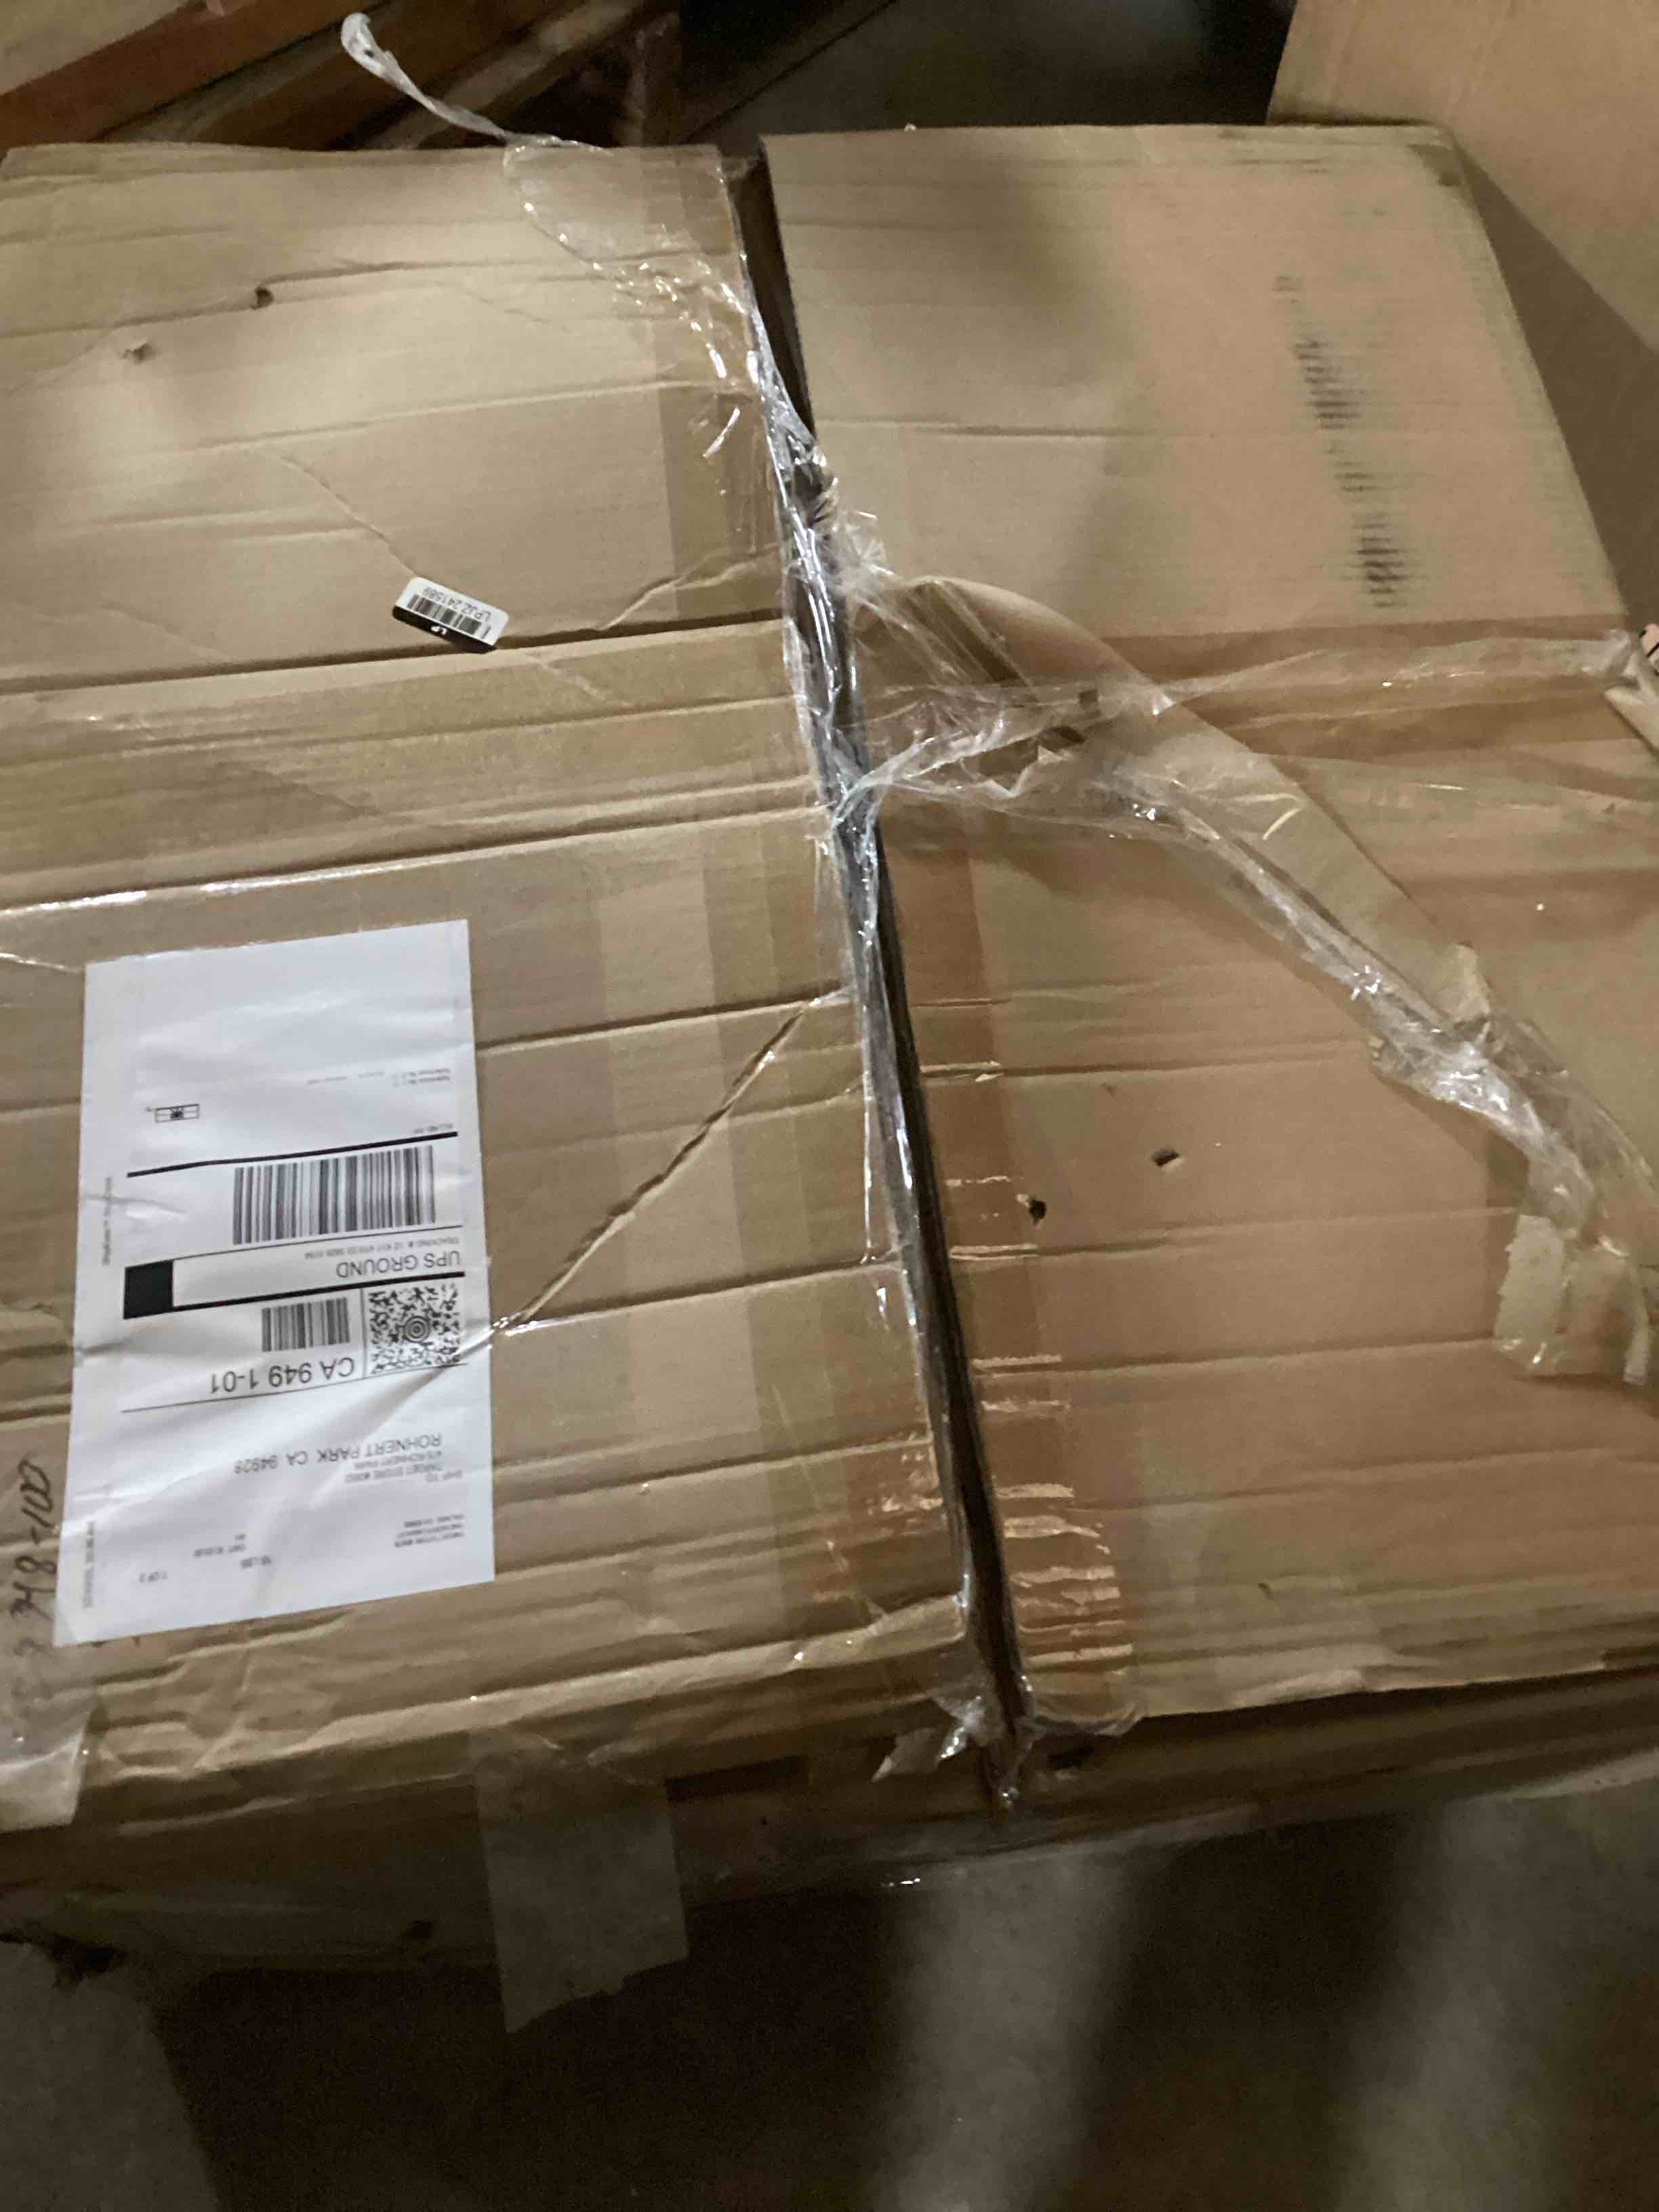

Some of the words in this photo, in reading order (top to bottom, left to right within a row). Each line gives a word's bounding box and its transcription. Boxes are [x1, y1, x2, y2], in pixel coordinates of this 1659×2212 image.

[336, 1255, 417, 1278] GROUND
[424, 1251, 460, 1269] UPS
[268, 1363, 312, 1388] 949
[319, 1357, 355, 1380] CA
[209, 1369, 259, 1395] 1-01
[316, 1446, 361, 1462] PARK
[364, 1433, 442, 1458] ROHNERT
[286, 1450, 308, 1465] CA
